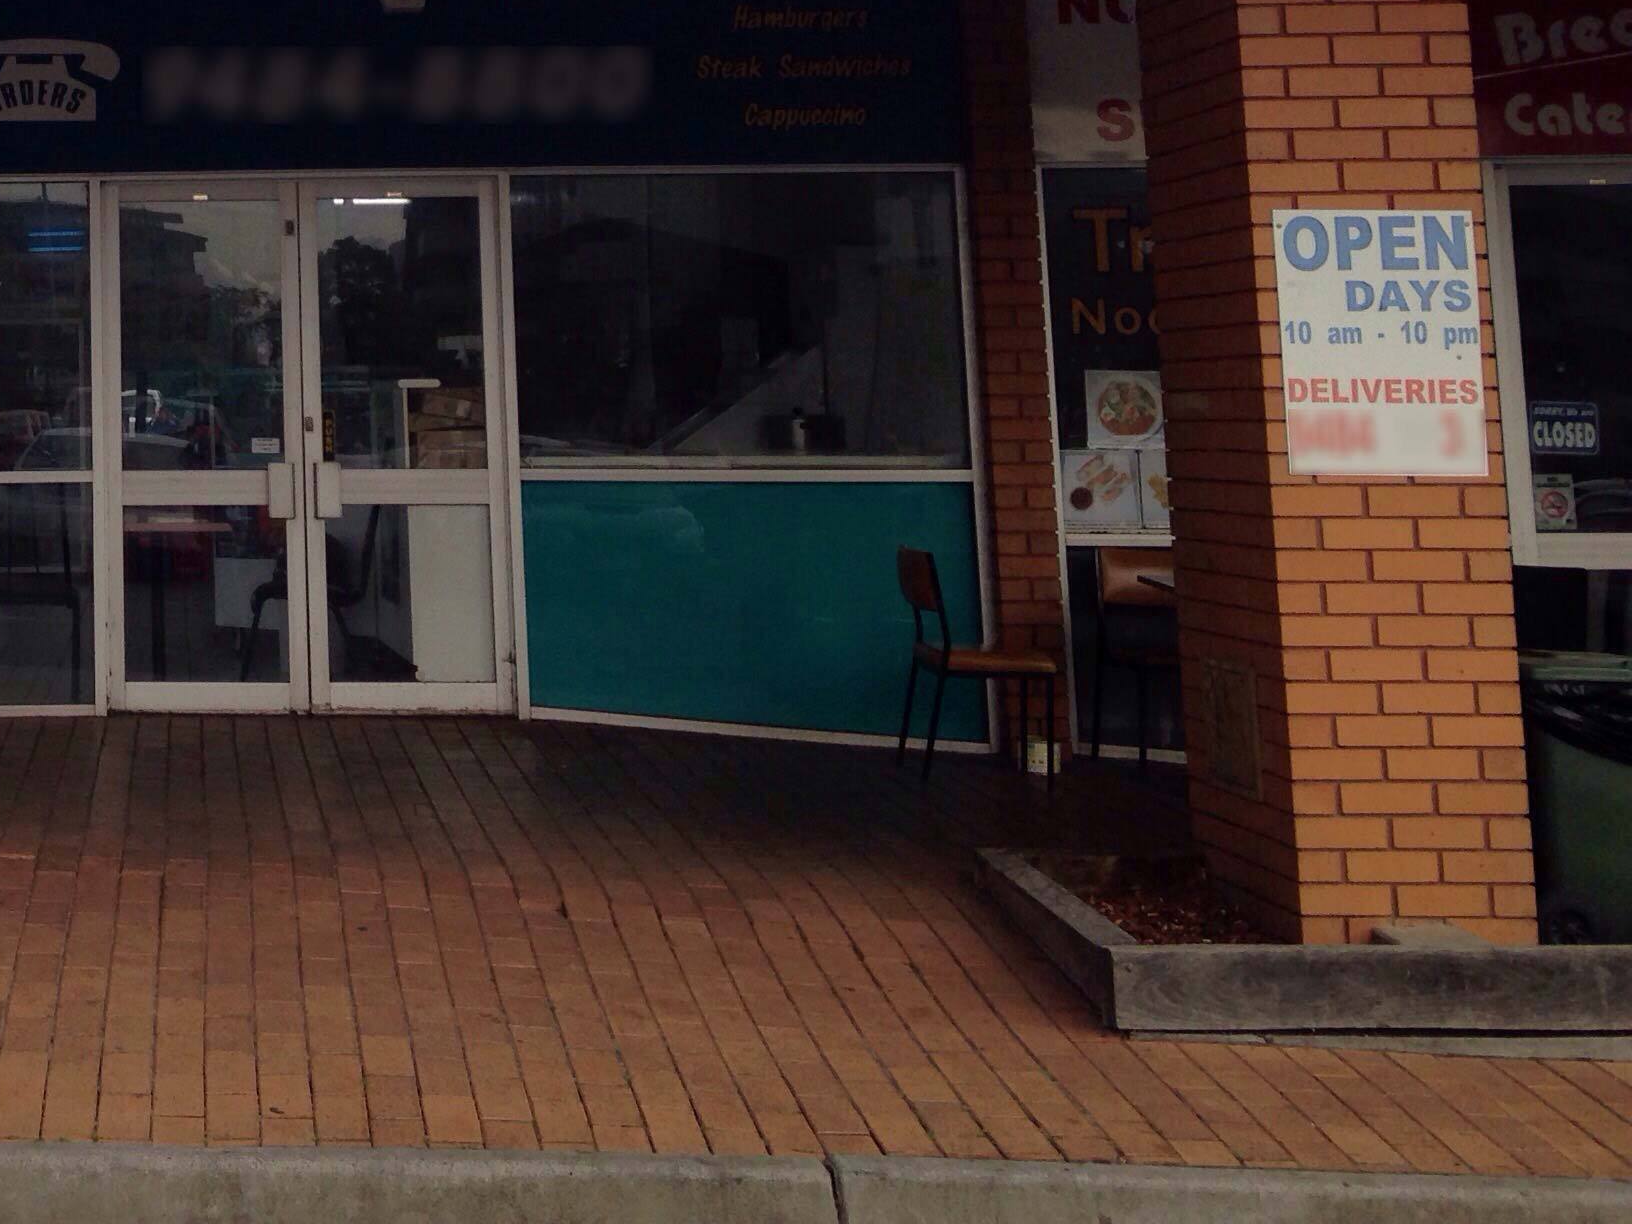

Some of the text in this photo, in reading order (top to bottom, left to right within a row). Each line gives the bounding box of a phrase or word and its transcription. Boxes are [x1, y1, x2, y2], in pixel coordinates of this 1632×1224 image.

[731, 3, 869, 33] Hamburgers
[695, 53, 913, 80] Steak Sandwiches
[743, 102, 866, 133] Cappuccino
[1283, 215, 1469, 271] OPEN
[1345, 280, 1472, 312] DAYS
[1285, 321, 1312, 344] 10
[1328, 325, 1362, 344] am
[1401, 321, 1427, 344] 10
[1444, 325, 1478, 350] pm
[1287, 378, 1479, 405] DELIVERIES
[1533, 420, 1596, 448] CLOSED
